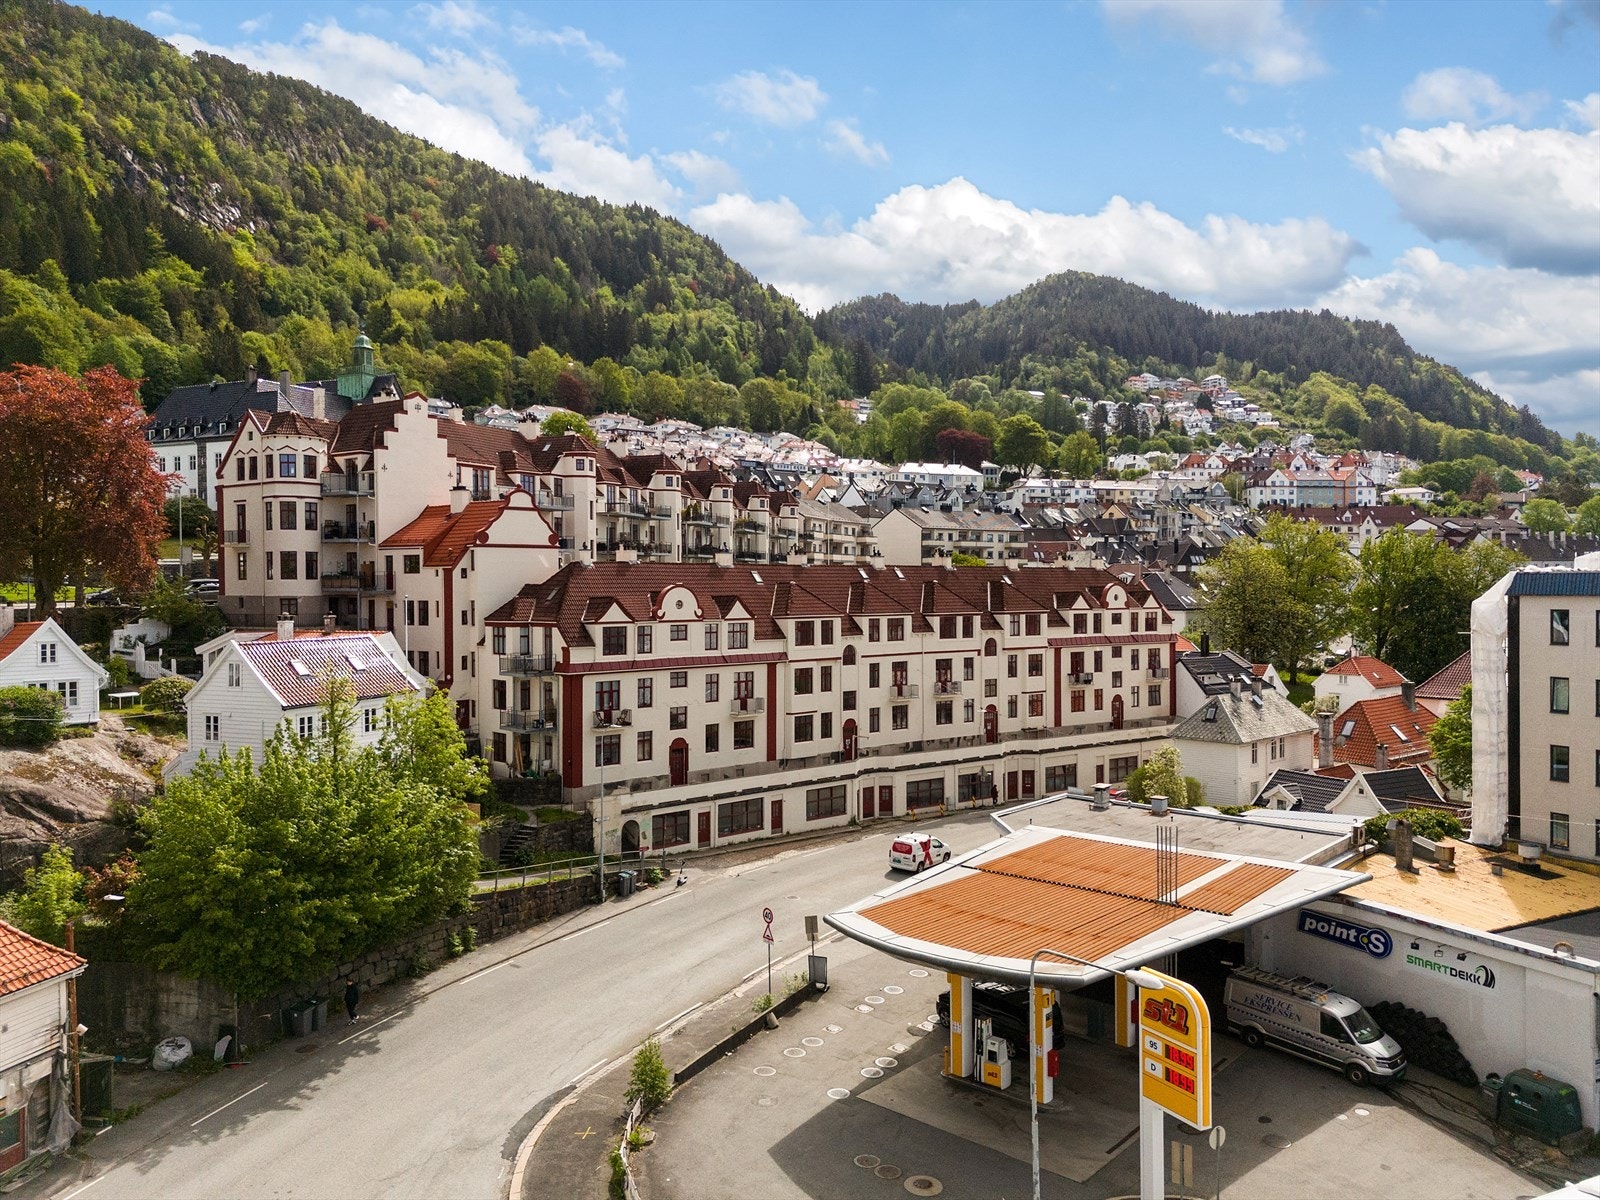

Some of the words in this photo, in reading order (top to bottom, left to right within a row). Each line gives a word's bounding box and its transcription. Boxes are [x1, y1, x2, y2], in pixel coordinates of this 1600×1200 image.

[1304, 916, 1357, 943] point
[1368, 933, 1385, 953] S
[1254, 992, 1293, 1011] SERVICE
[1149, 1040, 1158, 1050] 95
[1150, 1063, 1157, 1071] D
